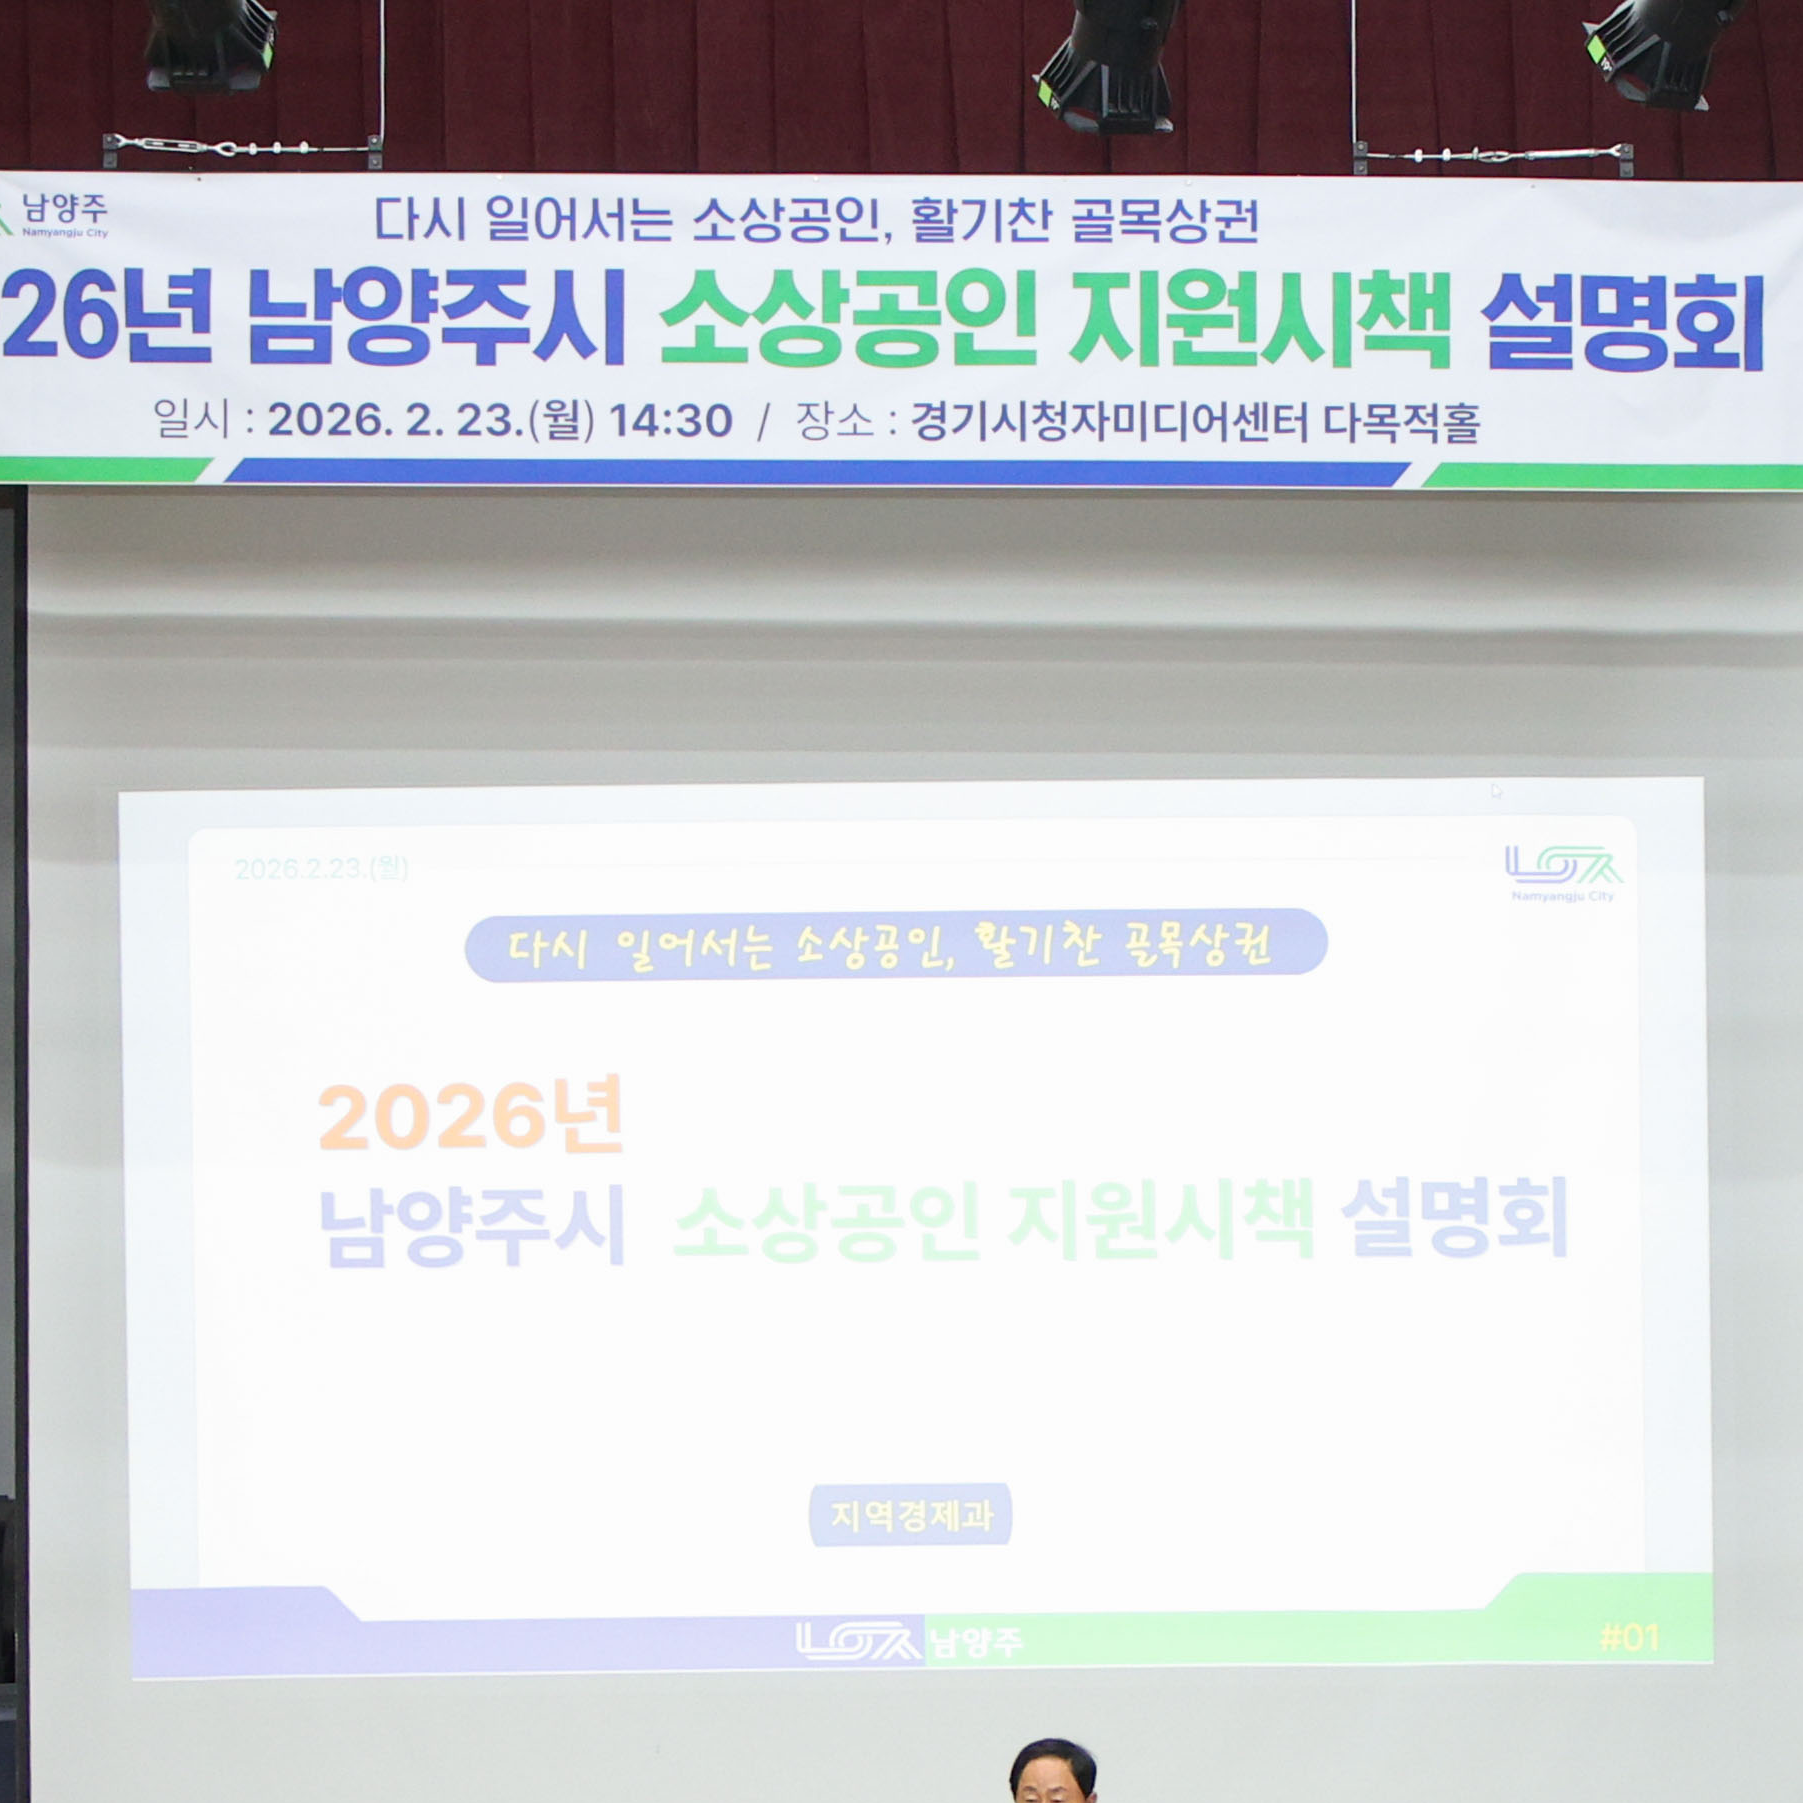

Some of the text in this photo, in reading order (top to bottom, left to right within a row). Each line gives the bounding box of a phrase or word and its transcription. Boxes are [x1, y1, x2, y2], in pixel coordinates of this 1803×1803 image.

[22, 193, 108, 224] 남양주
[375, 195, 1259, 245] 다시 일어서는 소상공인, 활기찬 골목상권
[22, 227, 109, 241] Namyangju City
[249, 266, 625, 367] 남양주시
[660, 267, 1037, 369] 소상공인
[1070, 269, 1451, 370] 지원시책
[1481, 272, 1765, 373] 설명회
[154, 398, 229, 440] 일시
[268, 402, 393, 437] 2026.
[457, 399, 594, 443] 23.(월)
[610, 402, 733, 438] 14:30
[796, 401, 875, 442] 장소
[911, 400, 1308, 444] 경기시청자미디어센터
[1324, 402, 1481, 445] 다목적홀
[235, 854, 409, 882] 2026.2.23.(월)
[1511, 890, 1614, 904] Namyangju City
[509, 920, 1271, 973] 다시 일어서는 소상공인, 활기찬 골목상권
[318, 1072, 624, 1155] 2026년
[320, 1176, 1568, 1269] 남양주시 소상공인 지원시책 설명회
[831, 1498, 994, 1533] 지역경제과
[929, 1626, 1025, 1658] 남양주
[1599, 1623, 1660, 1652] #01
